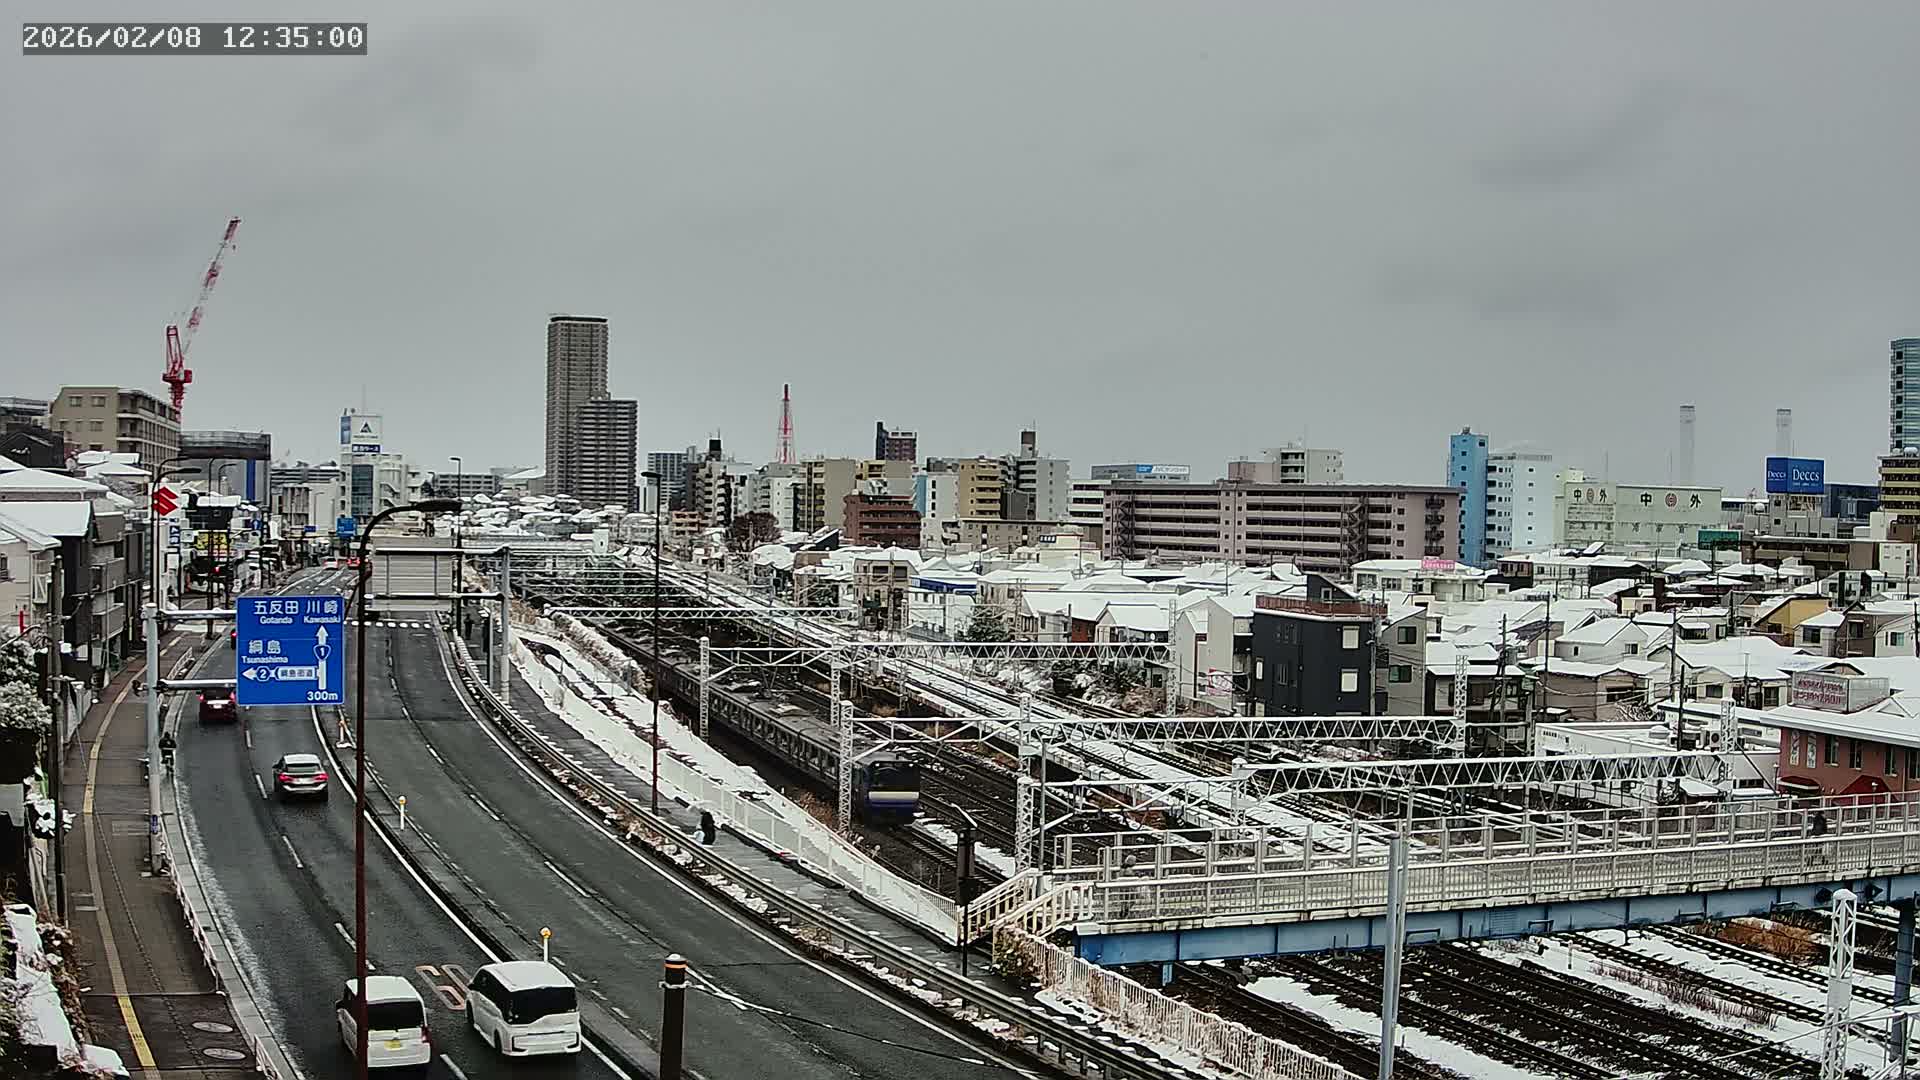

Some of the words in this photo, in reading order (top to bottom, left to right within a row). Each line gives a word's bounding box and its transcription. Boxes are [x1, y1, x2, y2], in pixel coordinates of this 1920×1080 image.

[1792, 468, 1820, 481] Deccs
[253, 600, 299, 615] 五反田
[306, 600, 338, 615] 川崎
[260, 616, 293, 624] Gotanda
[303, 616, 341, 624] Kawasaki
[319, 647, 325, 657] 1
[241, 655, 289, 664] Tsunashima
[260, 669, 267, 678] 2
[306, 690, 339, 701] 300m
